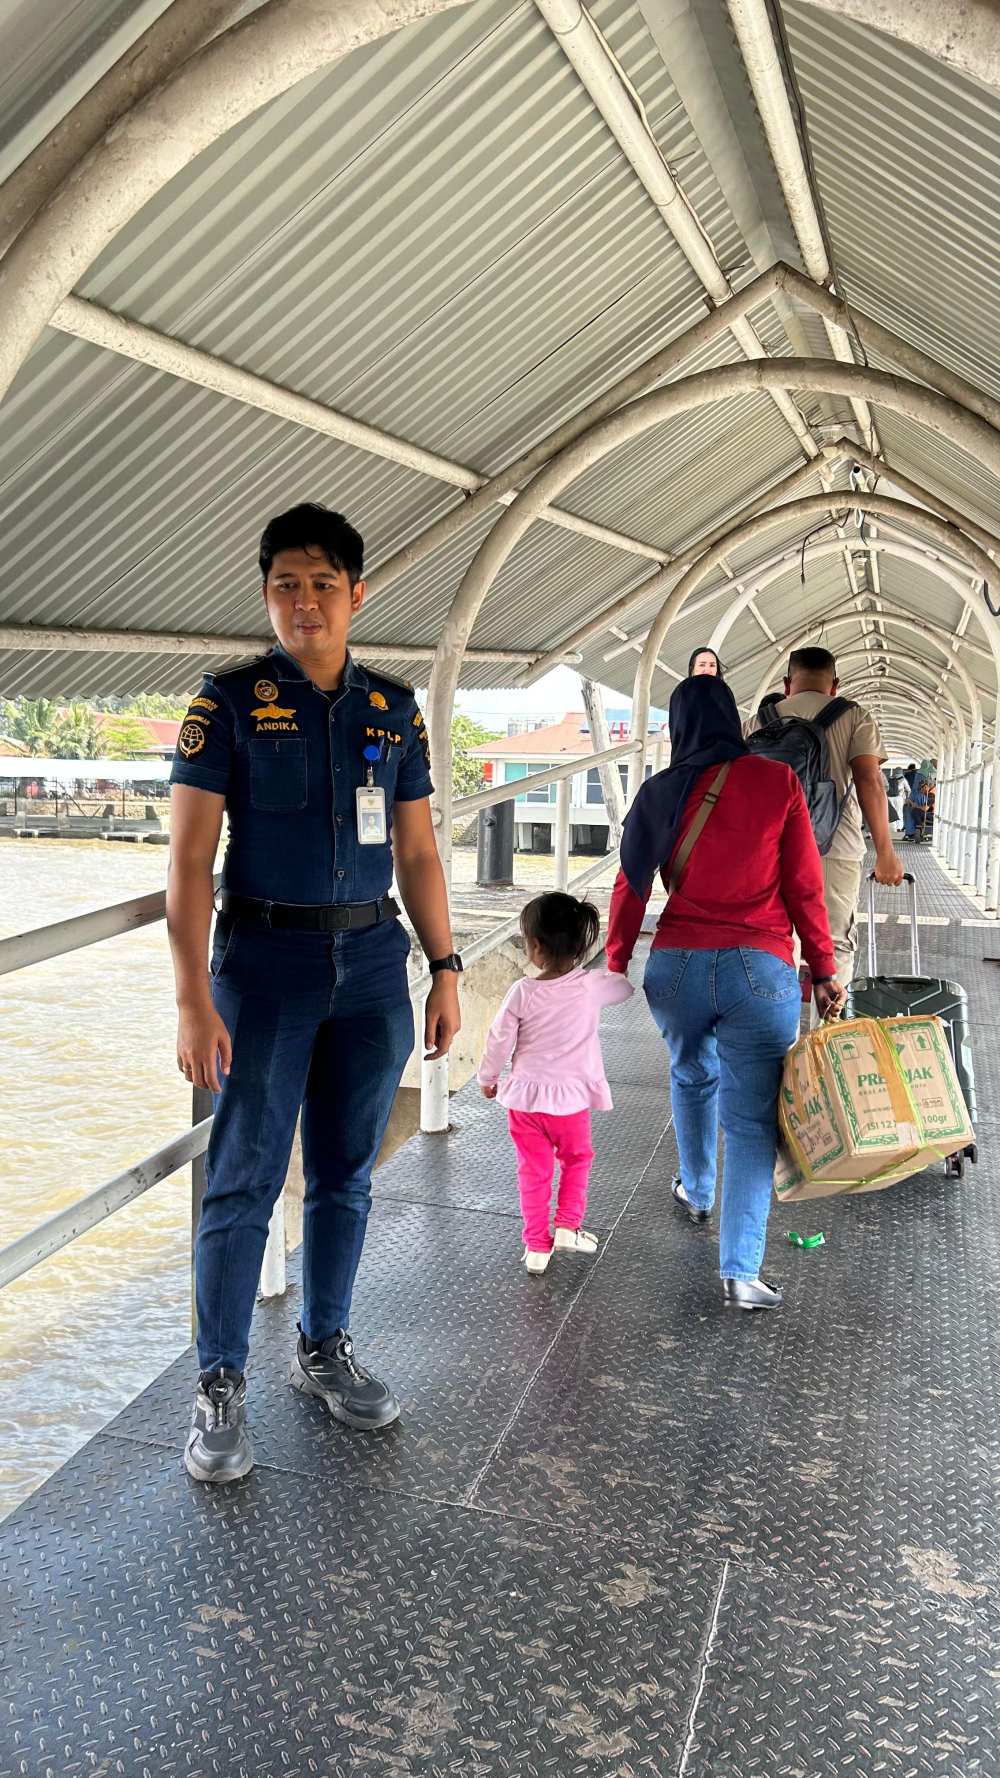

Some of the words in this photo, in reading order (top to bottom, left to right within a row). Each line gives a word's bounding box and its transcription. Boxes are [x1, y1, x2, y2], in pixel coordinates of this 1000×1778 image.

[256, 722, 299, 732] ANDIKA
[857, 1066, 934, 1088] PREJAK
[867, 1121, 878, 1130] ISI
[881, 1120, 892, 1129] 12
[922, 1115, 947, 1124] 100gr
